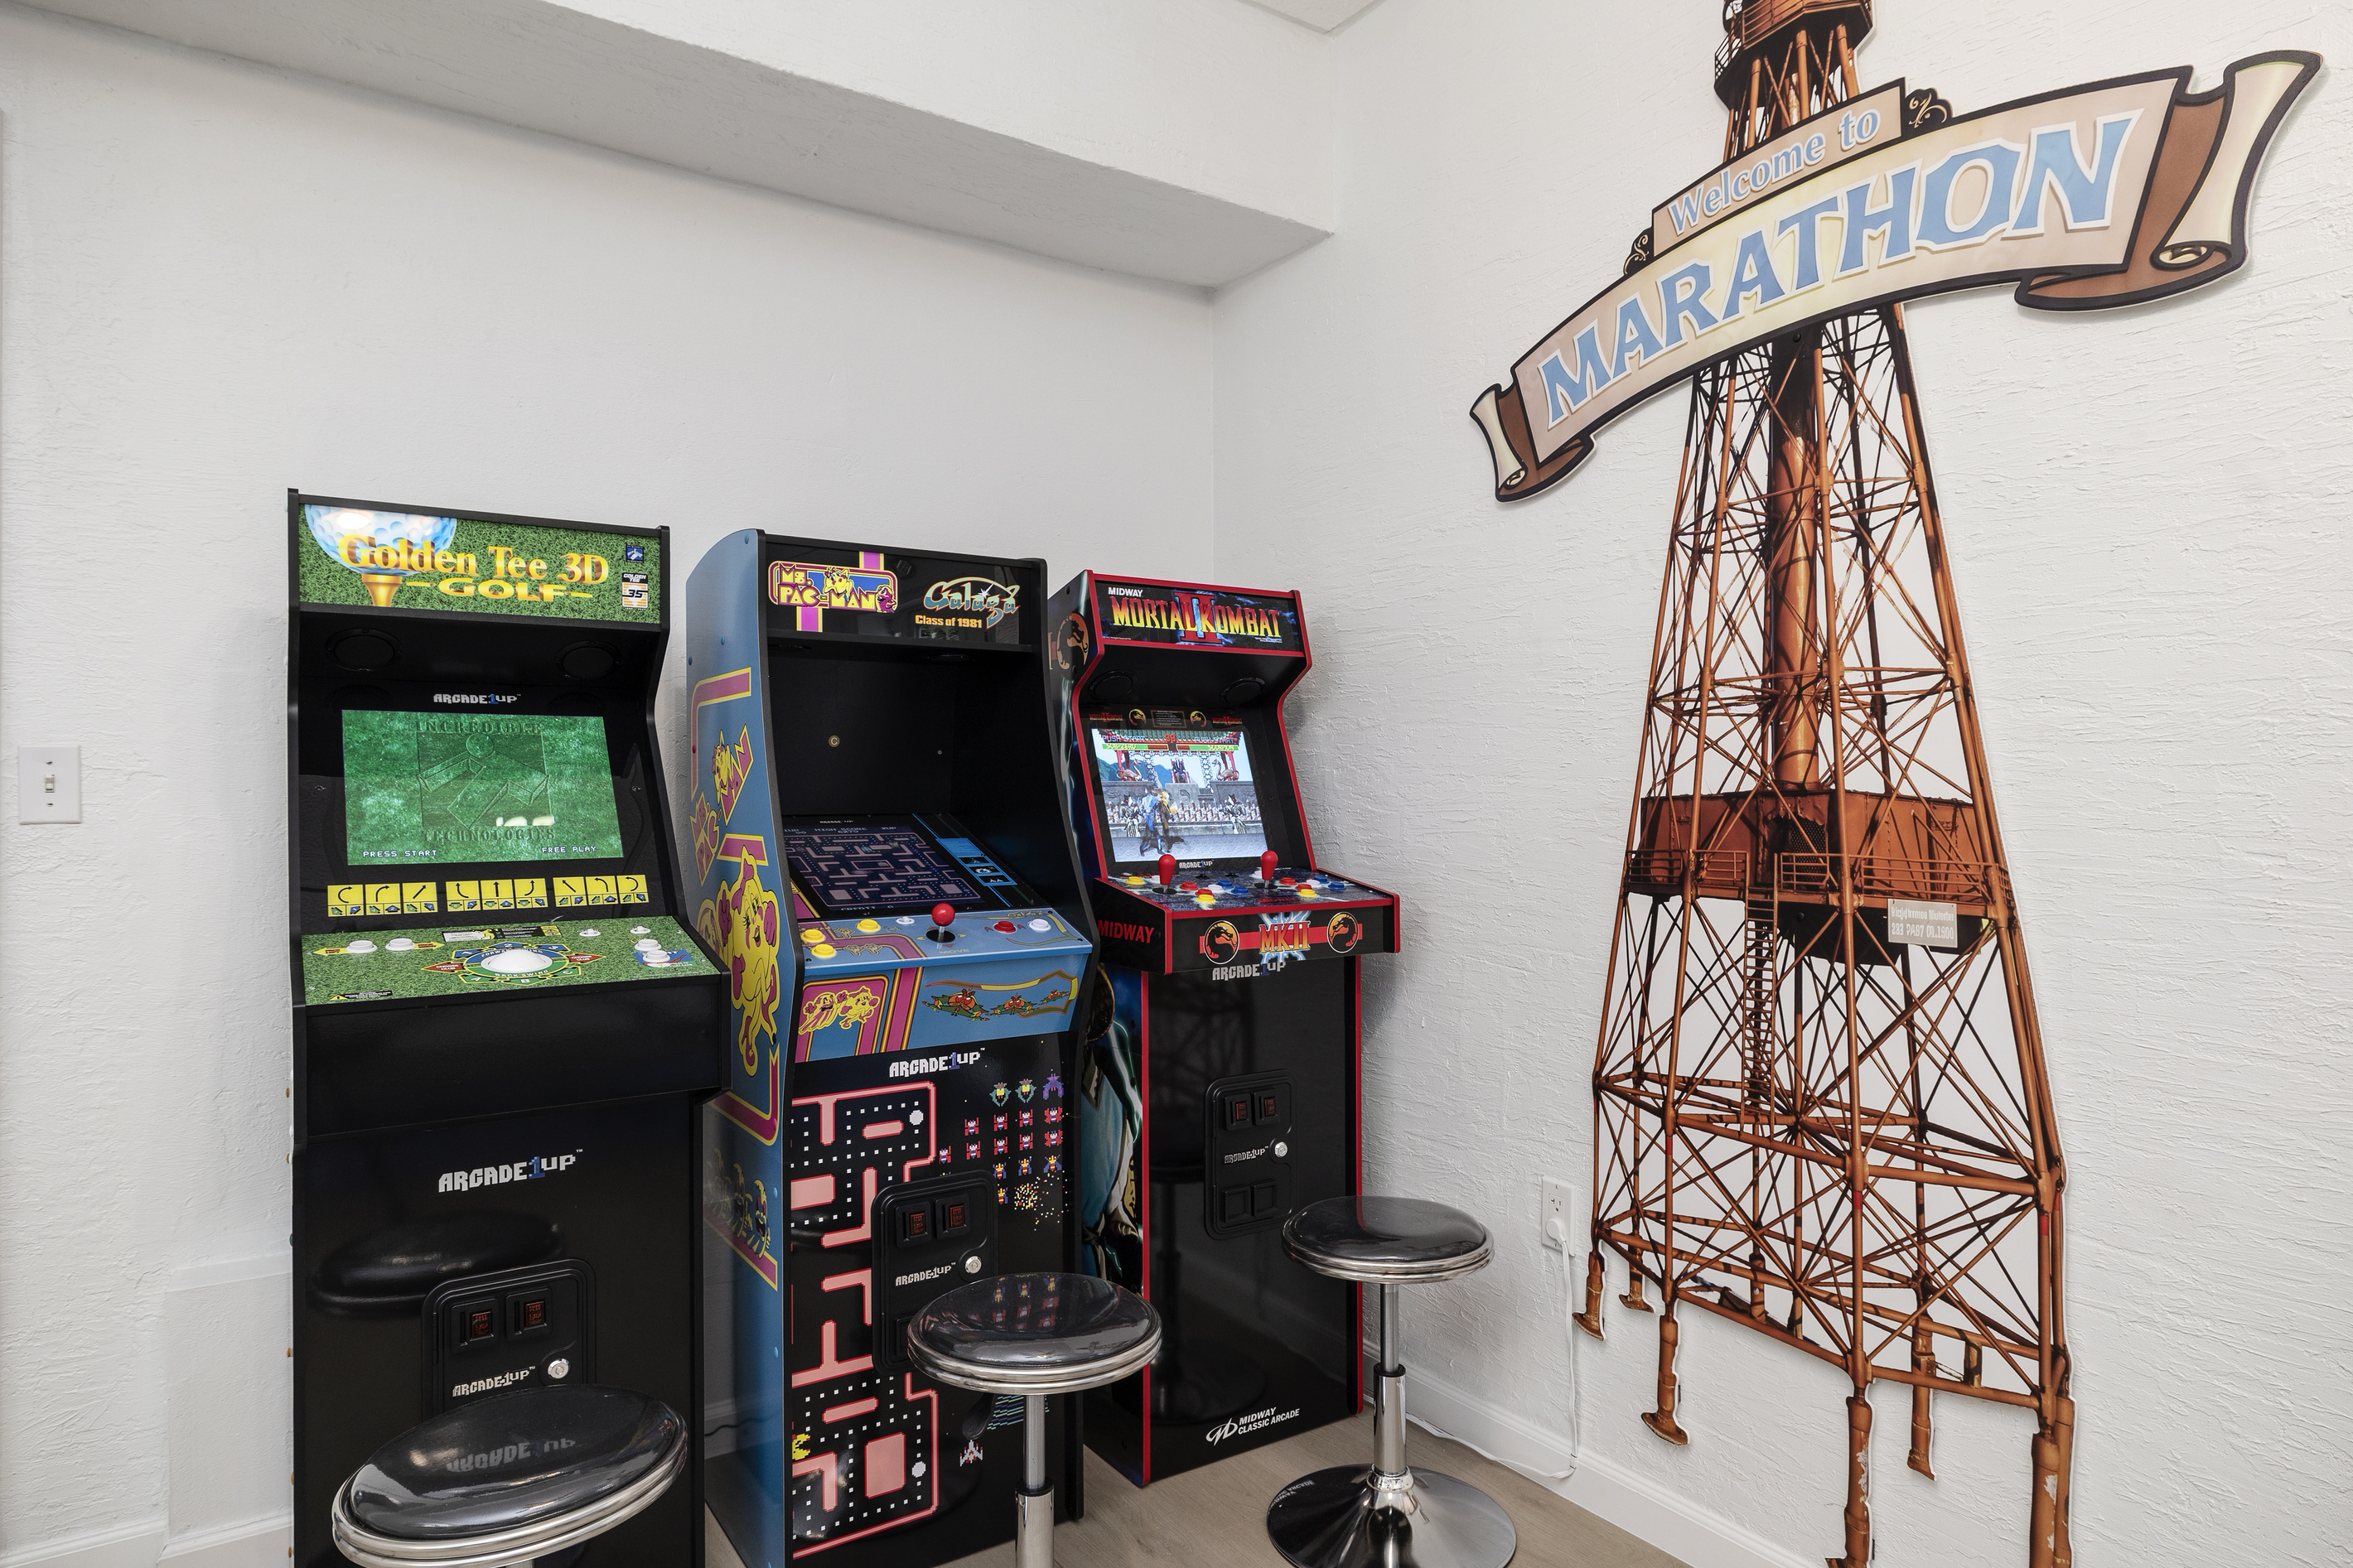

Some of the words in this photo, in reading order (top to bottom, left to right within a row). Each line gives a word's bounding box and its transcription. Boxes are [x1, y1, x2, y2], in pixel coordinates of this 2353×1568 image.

[1667, 133, 1827, 235] Welcome
[1838, 105, 1880, 147] to
[1539, 109, 2146, 431] MARATHON
[338, 534, 478, 576] Golden
[487, 545, 547, 580] Tee
[558, 552, 609, 584] 3D
[628, 589, 643, 598] 35
[778, 584, 877, 611] PAC-MAN
[1108, 586, 1143, 597] MIDWAY
[924, 577, 1020, 629] Galaga
[915, 615, 944, 626] Class
[945, 616, 955, 626] of
[957, 618, 983, 629] 1981
[1109, 596, 1198, 632] MORTAL
[1198, 603, 1282, 638] KOMBAT
[415, 720, 544, 734] INCREDIBLE
[423, 827, 557, 842] TECHNOLOGIES
[404, 849, 437, 857] START
[572, 845, 597, 853] PLAY
[1097, 919, 1155, 943] MIDWAY
[481, 948, 507, 958] FORWA
[1238, 1418, 1269, 1435] CLASSIC
[1270, 1408, 1300, 1424] ARCADE
[1239, 1407, 1277, 1425] MIDWAY
